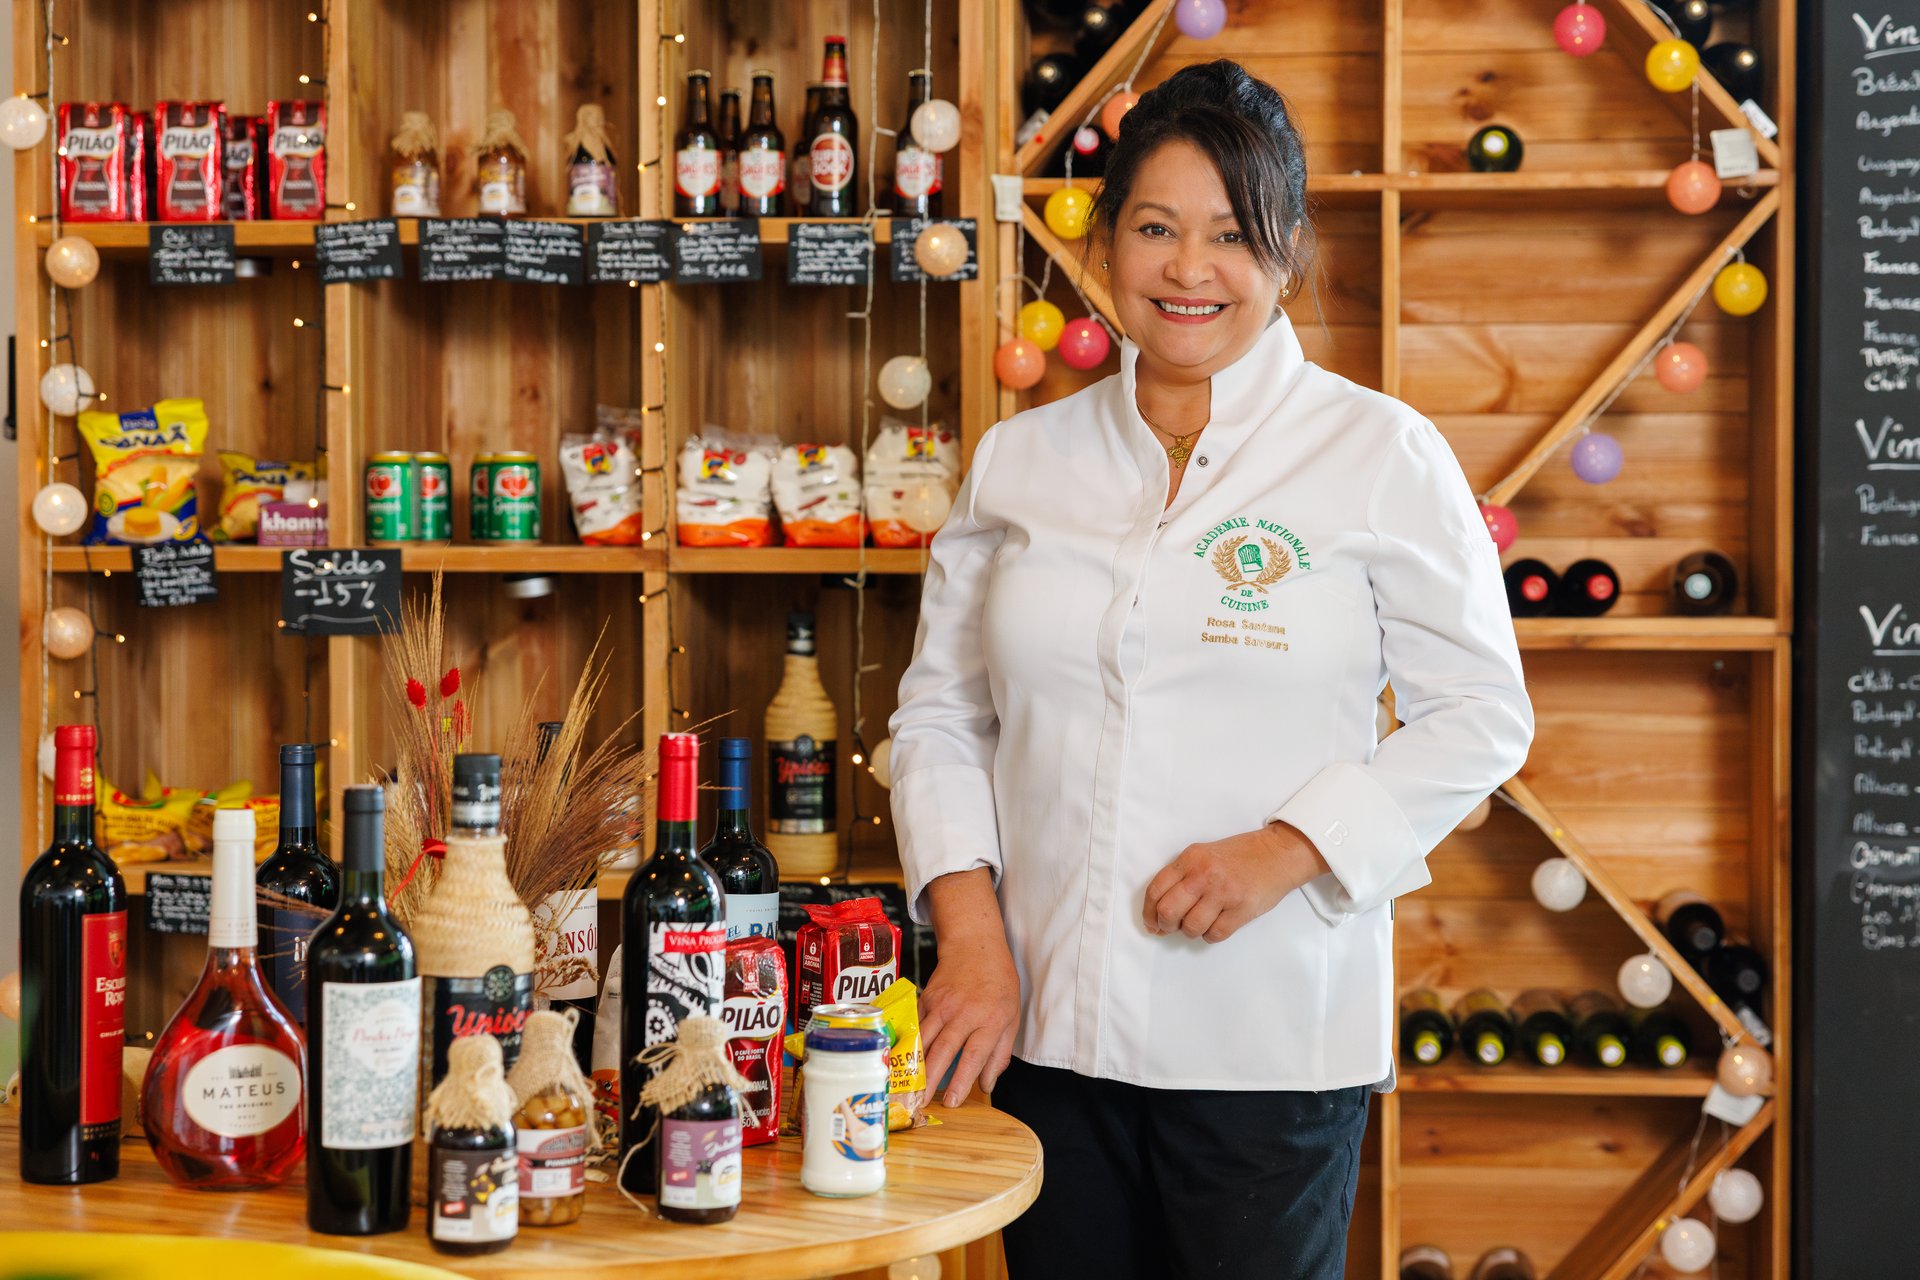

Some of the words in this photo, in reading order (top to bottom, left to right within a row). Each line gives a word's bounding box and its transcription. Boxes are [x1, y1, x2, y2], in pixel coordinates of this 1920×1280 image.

[68, 132, 116, 152] PILÃO
[163, 131, 211, 151] PILÃO
[1193, 517, 1250, 559] ACADEMIE
[1256, 519, 1312, 571] NATIONALE
[289, 548, 386, 577] Soldes
[1240, 589, 1254, 598] DE
[1220, 595, 1270, 612] CUISINE
[1207, 616, 1236, 629] Rosa
[1201, 632, 1239, 645] Samba
[668, 935, 697, 946] VIÑA
[804, 960, 820, 969] AROMA
[837, 969, 895, 1001] PILÃO
[446, 1003, 534, 1037] Ypióc
[722, 1001, 781, 1032] PILÃO
[891, 1054, 905, 1067] DE
[203, 1081, 286, 1100] MATEUS
[898, 1079, 911, 1088] MIX
